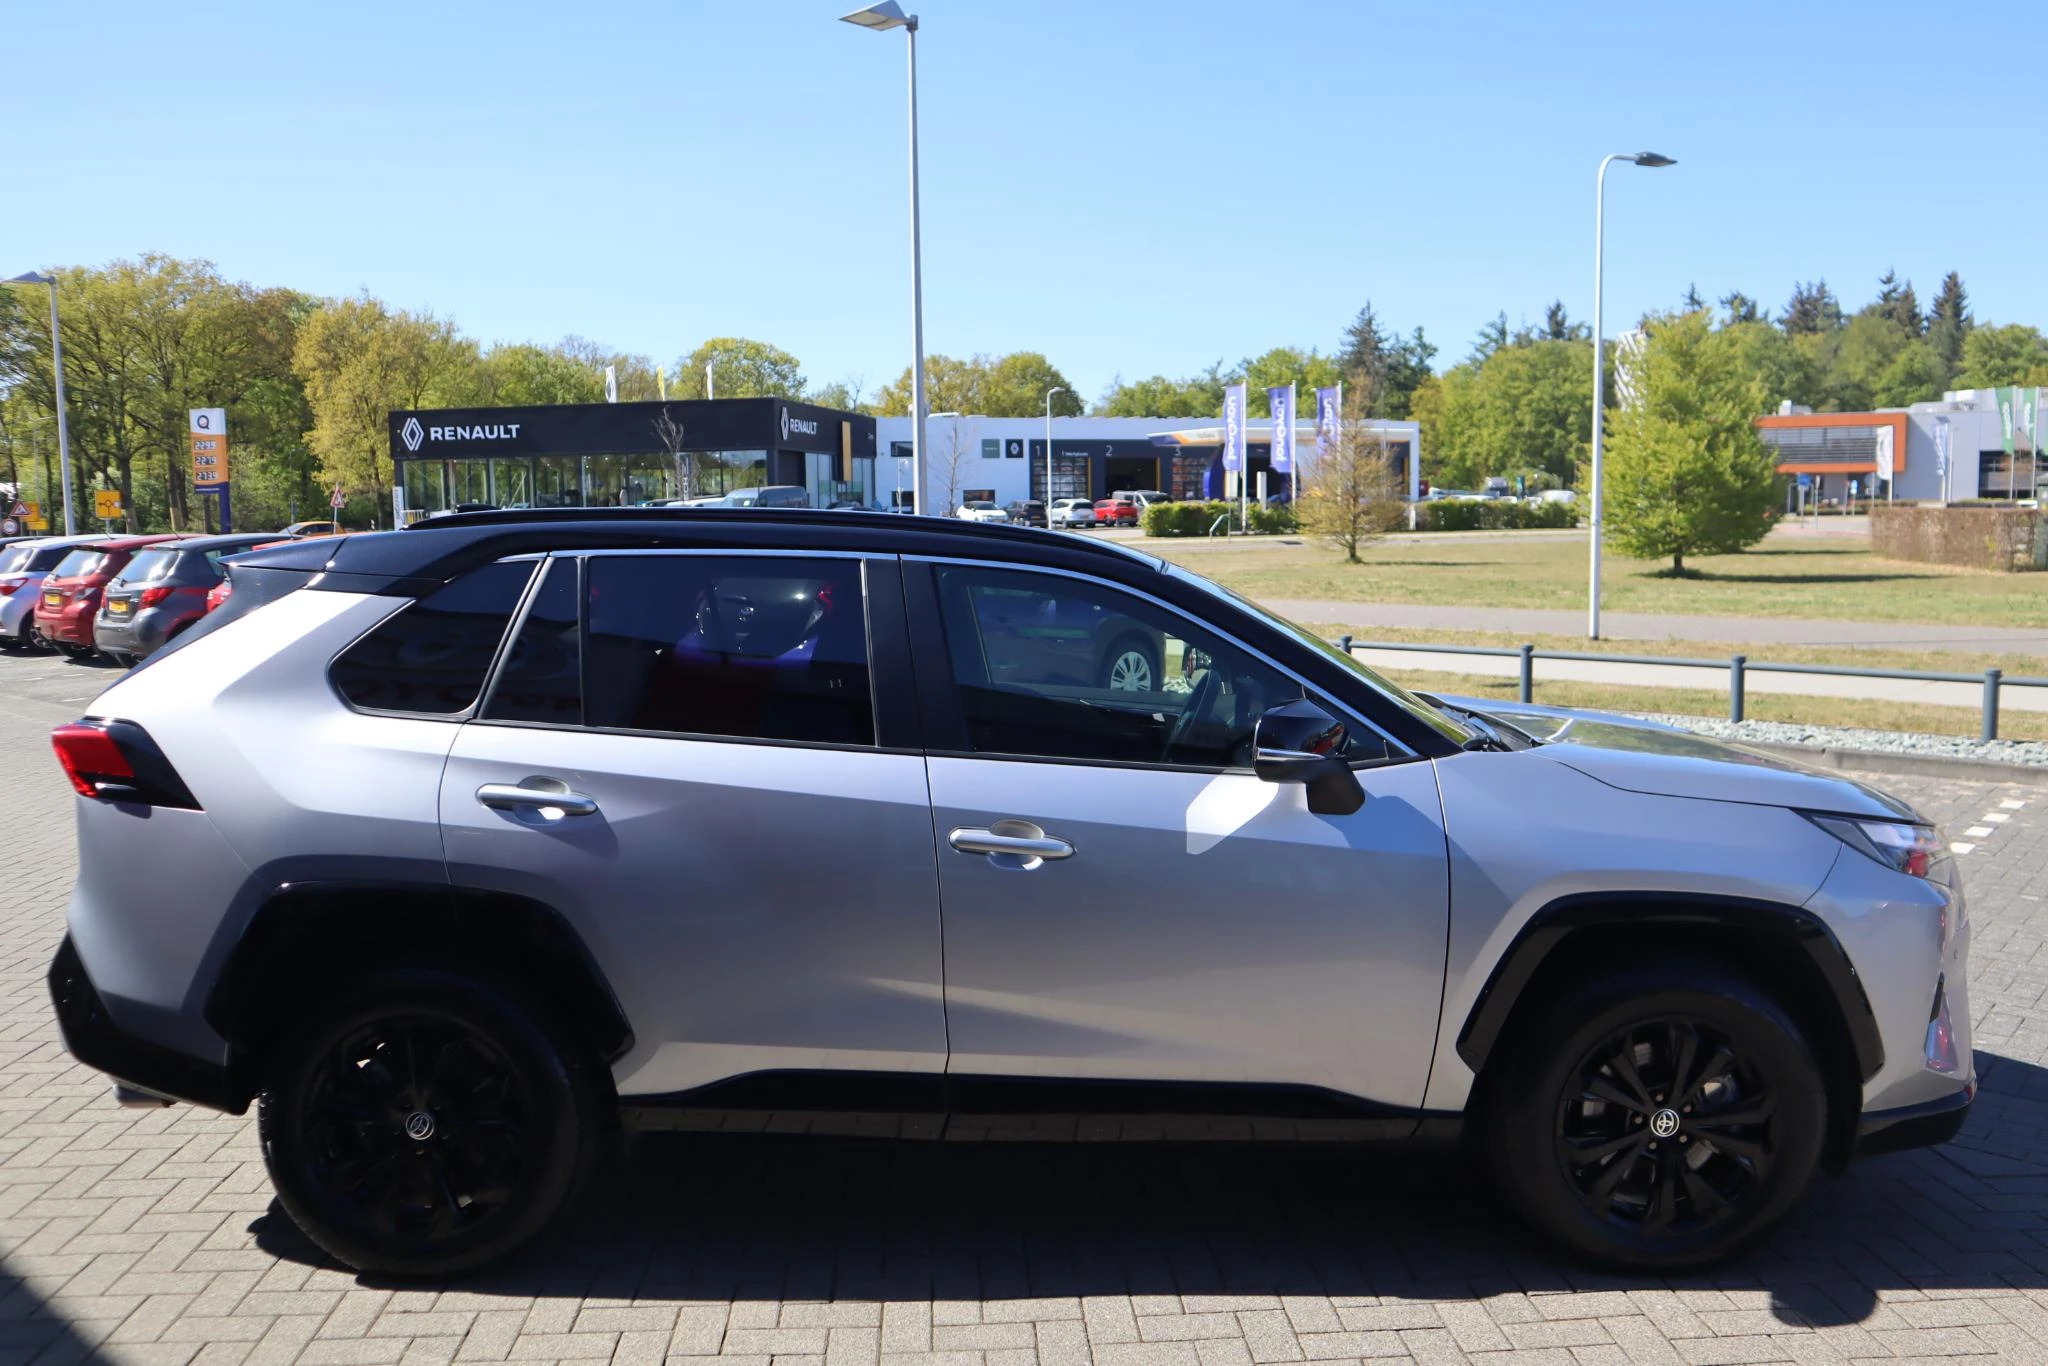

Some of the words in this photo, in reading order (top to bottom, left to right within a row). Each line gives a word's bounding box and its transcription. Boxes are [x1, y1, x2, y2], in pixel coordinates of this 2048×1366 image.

[197, 414, 210, 430] Q
[789, 418, 818, 435] RENAULT
[430, 424, 520, 441] RENAULT
[1105, 445, 1113, 457] 2
